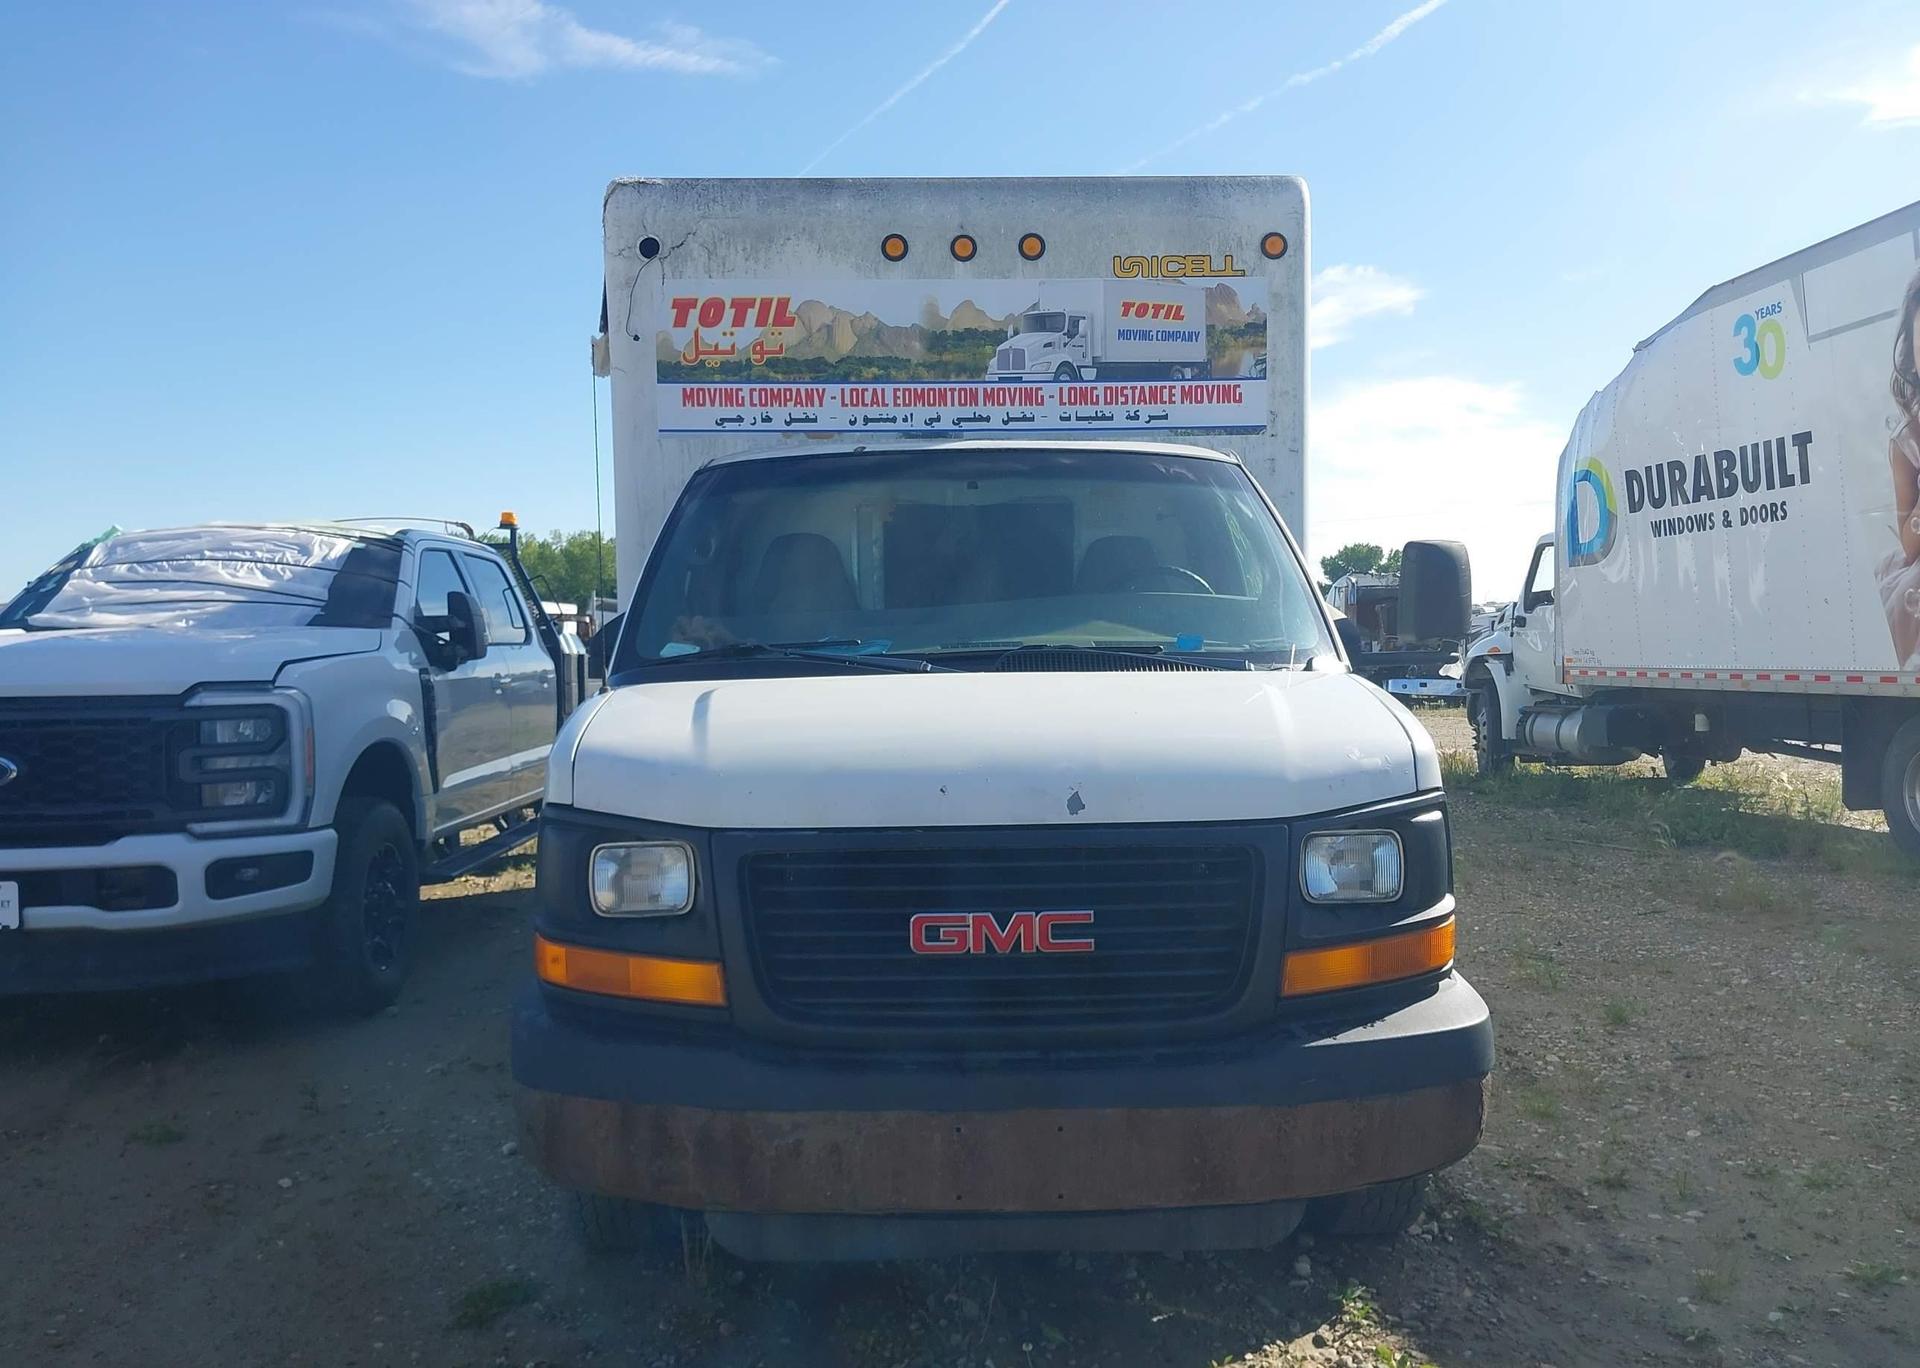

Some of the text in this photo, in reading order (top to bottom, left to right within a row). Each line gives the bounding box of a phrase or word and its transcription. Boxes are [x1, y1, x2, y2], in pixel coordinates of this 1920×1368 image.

[1113, 254, 1246, 278] UNICELL
[671, 296, 797, 328] TOTIL
[1121, 301, 1185, 321] TOTIL
[1755, 301, 1783, 321] YEARS
[1117, 328, 1200, 343] MOVING COMPANY
[1732, 313, 1786, 380] 30
[682, 387, 745, 408] MOVING
[749, 387, 826, 408] COMPANY
[841, 387, 889, 408] LOCAL
[893, 387, 979, 408] EDMONTON
[983, 386, 1045, 407] MOVING
[1058, 386, 1100, 406] LONG
[1103, 385, 1177, 406] DISTANCE
[1180, 384, 1243, 404] MOVING
[784, 411, 818, 427] نقل
[924, 411, 942, 428] في
[952, 411, 991, 428] محلي
[1002, 411, 1035, 426] نقل
[1125, 409, 1169, 424] شركة
[1624, 430, 1813, 514] DURABUILT
[1650, 500, 1789, 539] WINDOWS & DOORS
[910, 909, 1095, 955] GMC
